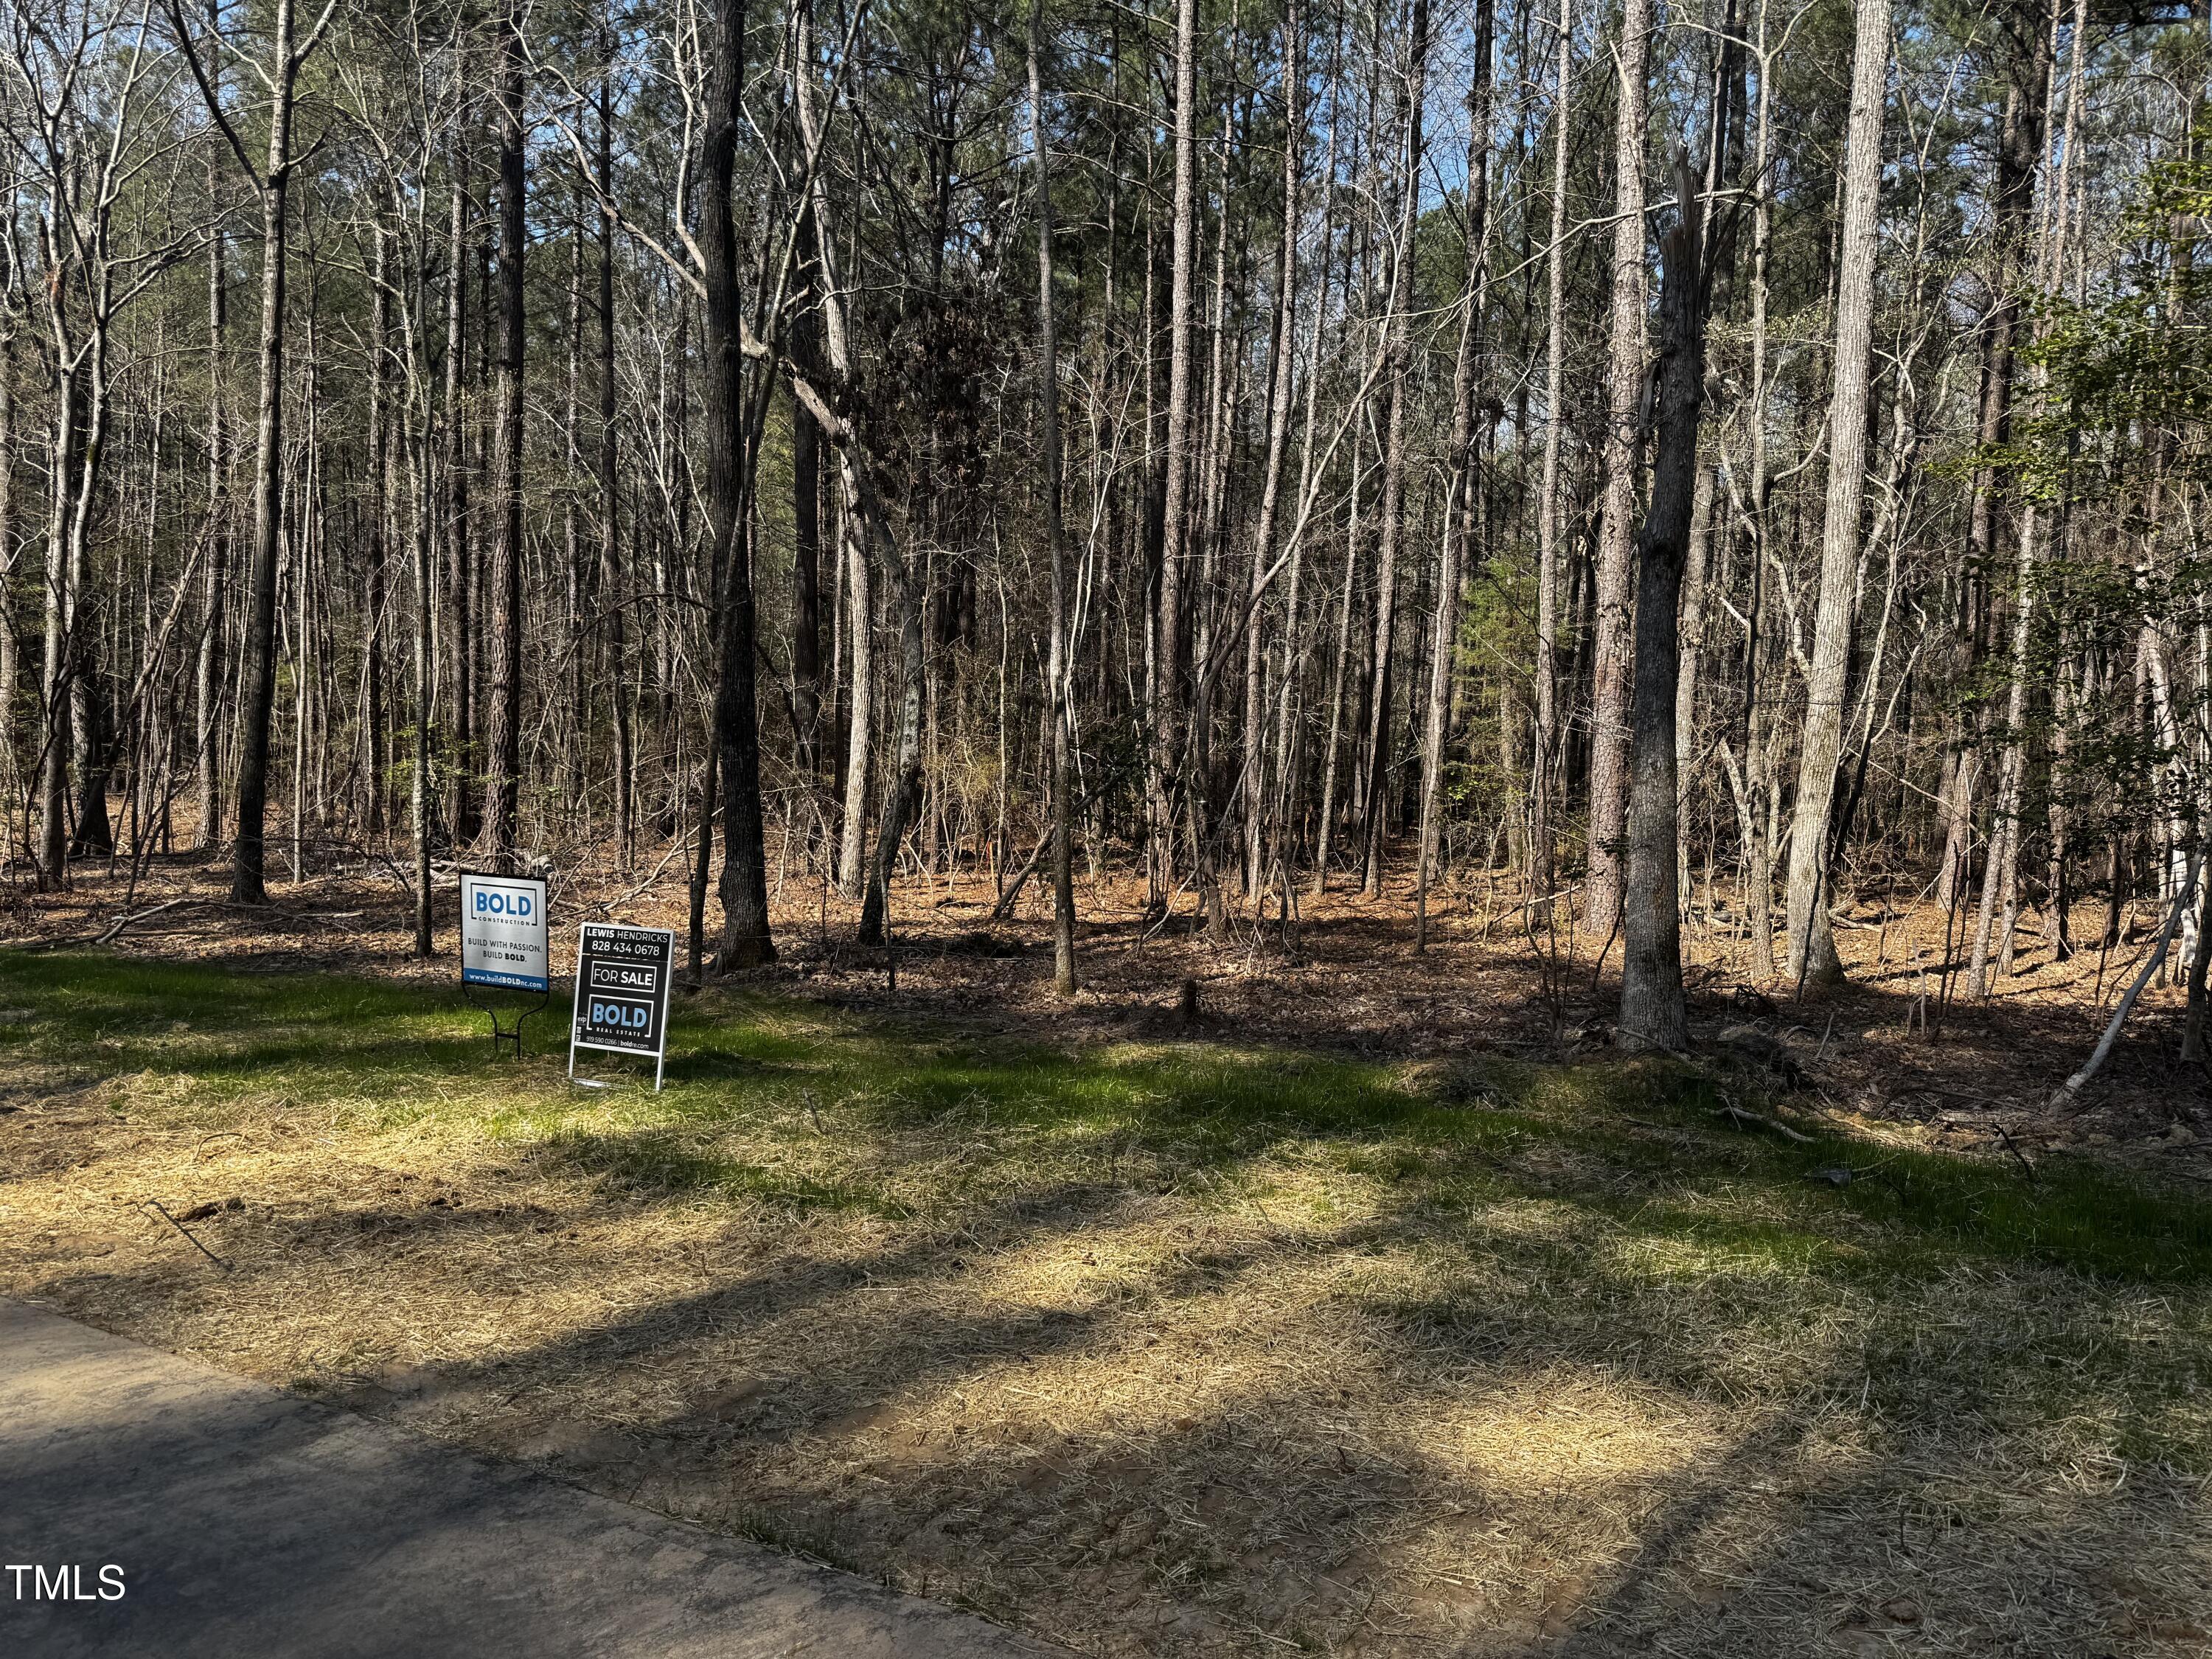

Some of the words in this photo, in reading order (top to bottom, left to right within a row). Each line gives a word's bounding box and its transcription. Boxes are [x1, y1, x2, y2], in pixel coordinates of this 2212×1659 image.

[476, 892, 531, 916] BOLD
[479, 916, 529, 925] CONSTRUCTION
[587, 928, 614, 937] LEWIS
[617, 931, 667, 942] HENDRICKS
[468, 937, 487, 947] BUILD
[490, 940, 507, 949] WITH
[509, 942, 542, 953] PASSION.
[591, 940, 611, 950] 828
[613, 942, 632, 953] 434
[635, 945, 660, 956] 0678
[483, 950, 503, 959] BUILD
[504, 953, 527, 962] BOLD.
[470, 974, 542, 988] www.buildBOLDnc.com
[594, 968, 618, 982] FOR
[621, 971, 653, 987] SALE
[592, 1004, 647, 1028] BOLD
[620, 1040, 649, 1049] boldre.com
